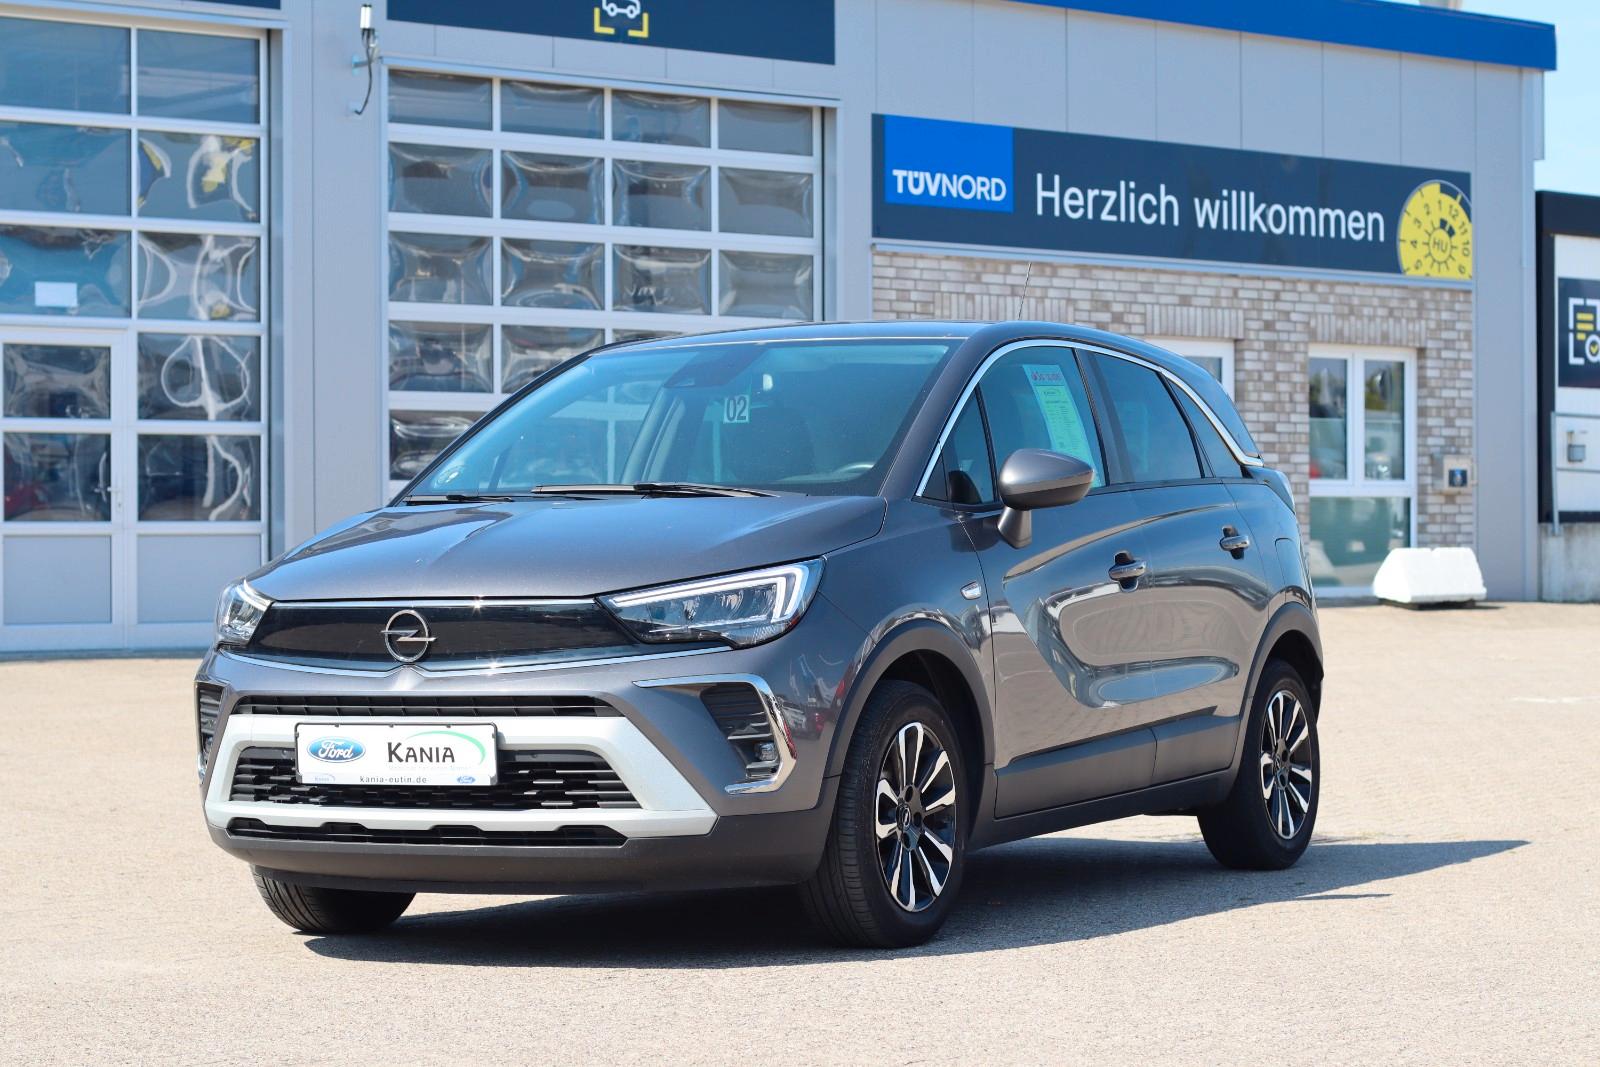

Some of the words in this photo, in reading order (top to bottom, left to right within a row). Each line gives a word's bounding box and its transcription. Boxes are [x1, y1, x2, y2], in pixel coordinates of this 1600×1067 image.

[1036, 173, 1179, 226] Herzlich
[1194, 190, 1385, 242] willkommen
[1449, 204, 1460, 221] 12
[1432, 237, 1448, 253] HU
[726, 395, 747, 422] 02
[318, 740, 354, 759] Ford
[387, 742, 455, 763] KANIA
[359, 775, 428, 784] kania-eutin.de
